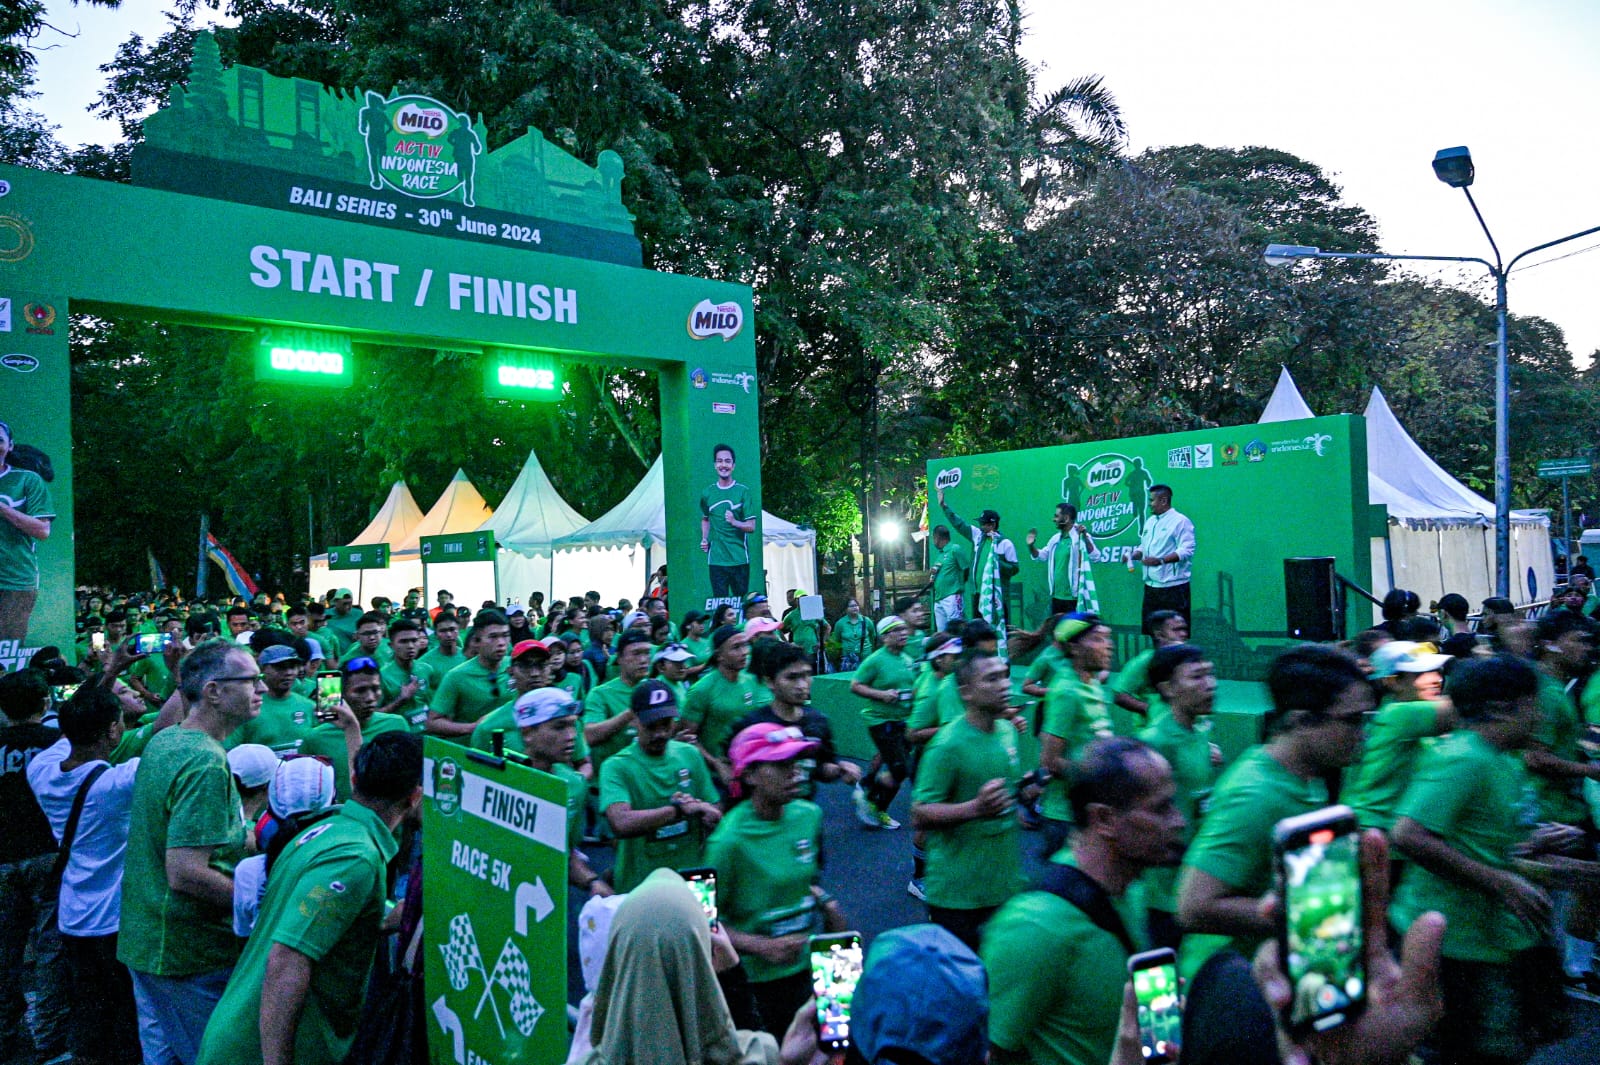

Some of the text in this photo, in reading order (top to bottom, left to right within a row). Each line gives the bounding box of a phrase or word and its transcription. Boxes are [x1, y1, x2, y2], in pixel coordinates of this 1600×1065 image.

[400, 112, 443, 130] MILO
[381, 155, 459, 177] INDONESIA
[401, 173, 440, 190] RACE
[289, 186, 332, 209] BALI
[335, 194, 397, 220] SERIES
[418, 208, 453, 228] 30th
[456, 216, 497, 237] June
[501, 223, 542, 245] 2024
[249, 244, 578, 324] START / FINISH
[694, 311, 738, 330] MILO
[937, 473, 960, 487] MILO
[1090, 467, 1121, 484] MILO
[1076, 501, 1134, 523] INDONESIA
[1091, 516, 1119, 534] RACE
[649, 689, 669, 705] D
[482, 785, 538, 833] FINISH
[451, 839, 512, 892] RACE 5K
